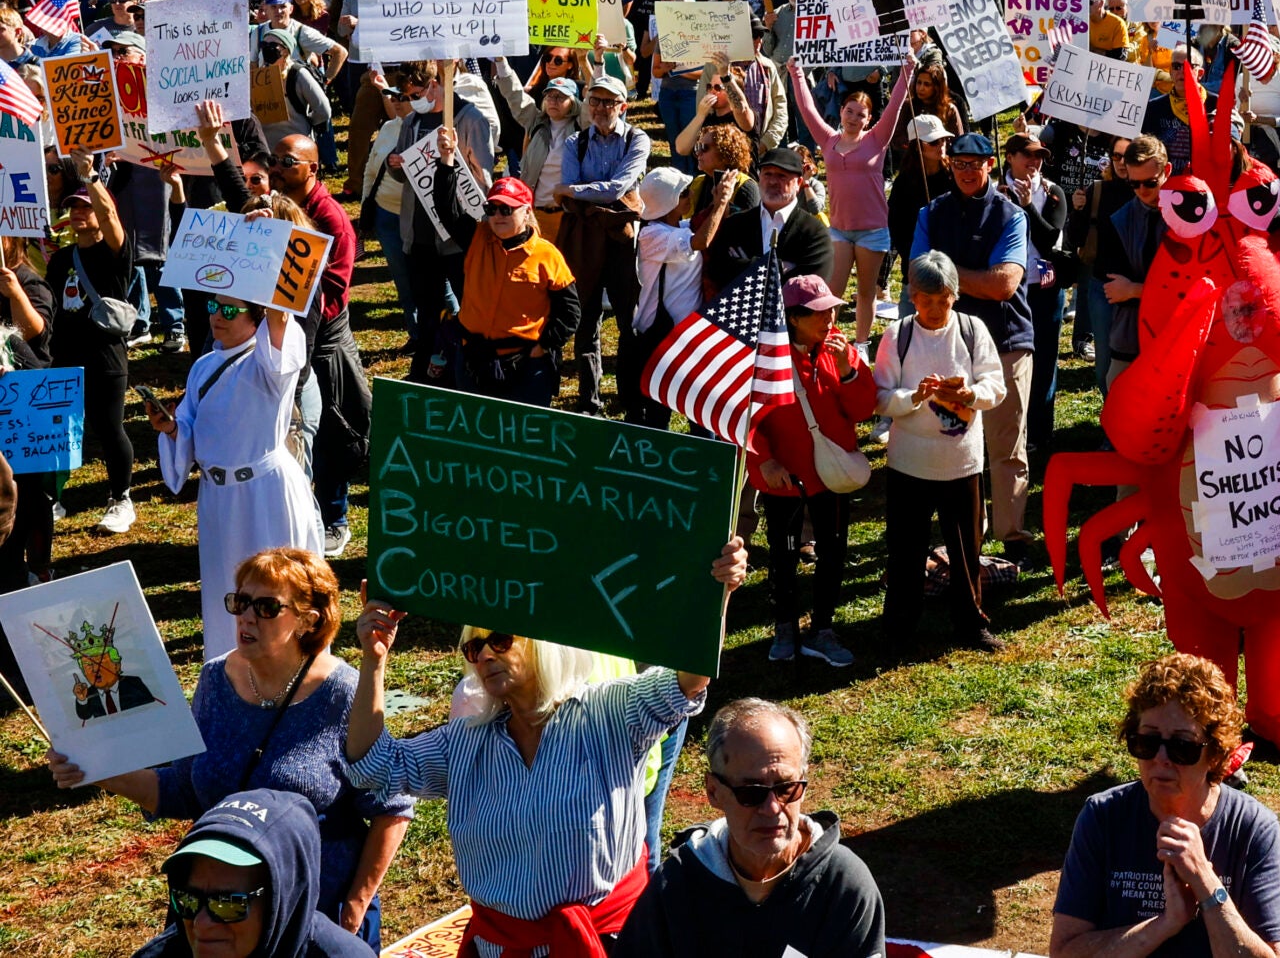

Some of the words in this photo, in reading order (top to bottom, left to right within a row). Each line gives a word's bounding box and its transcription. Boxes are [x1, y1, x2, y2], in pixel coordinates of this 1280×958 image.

[382, 1, 423, 18] WHO
[434, 2, 462, 15] DID
[472, 0, 510, 15] NOT
[154, 23, 179, 40] This
[182, 23, 192, 38] is
[196, 21, 219, 37] what
[222, 20, 233, 31] an
[390, 25, 442, 41] SPEAK
[543, 25, 570, 39] HERE
[943, 12, 1001, 53] CRACY
[174, 39, 221, 60] ANGRY
[952, 35, 1014, 75] NEEDS
[52, 61, 80, 84] No
[159, 63, 203, 89] SOCIAL
[205, 56, 245, 78] WORKER
[1058, 49, 1078, 75] I
[1087, 60, 1144, 92] PREFER
[52, 82, 110, 103] Kings
[204, 82, 229, 99] like!
[1049, 80, 1112, 113] CRUSHED
[1121, 101, 1142, 122] ICE
[56, 100, 112, 122] Since
[64, 117, 114, 146] 1776
[190, 211, 239, 234] MAY
[246, 222, 272, 237] the
[182, 233, 239, 251] FORCE
[174, 251, 216, 264] WITH
[400, 392, 577, 460] TEACHER
[5, 433, 18, 444] of
[1224, 434, 1264, 463] NO
[379, 436, 696, 532] AUTHORITARIAN
[379, 490, 559, 554] BIGOTED
[376, 547, 545, 616] CORRUPT
[1122, 881, 1136, 889] THE
[1122, 890, 1145, 898] MEAN
[1148, 891, 1158, 899] TO
